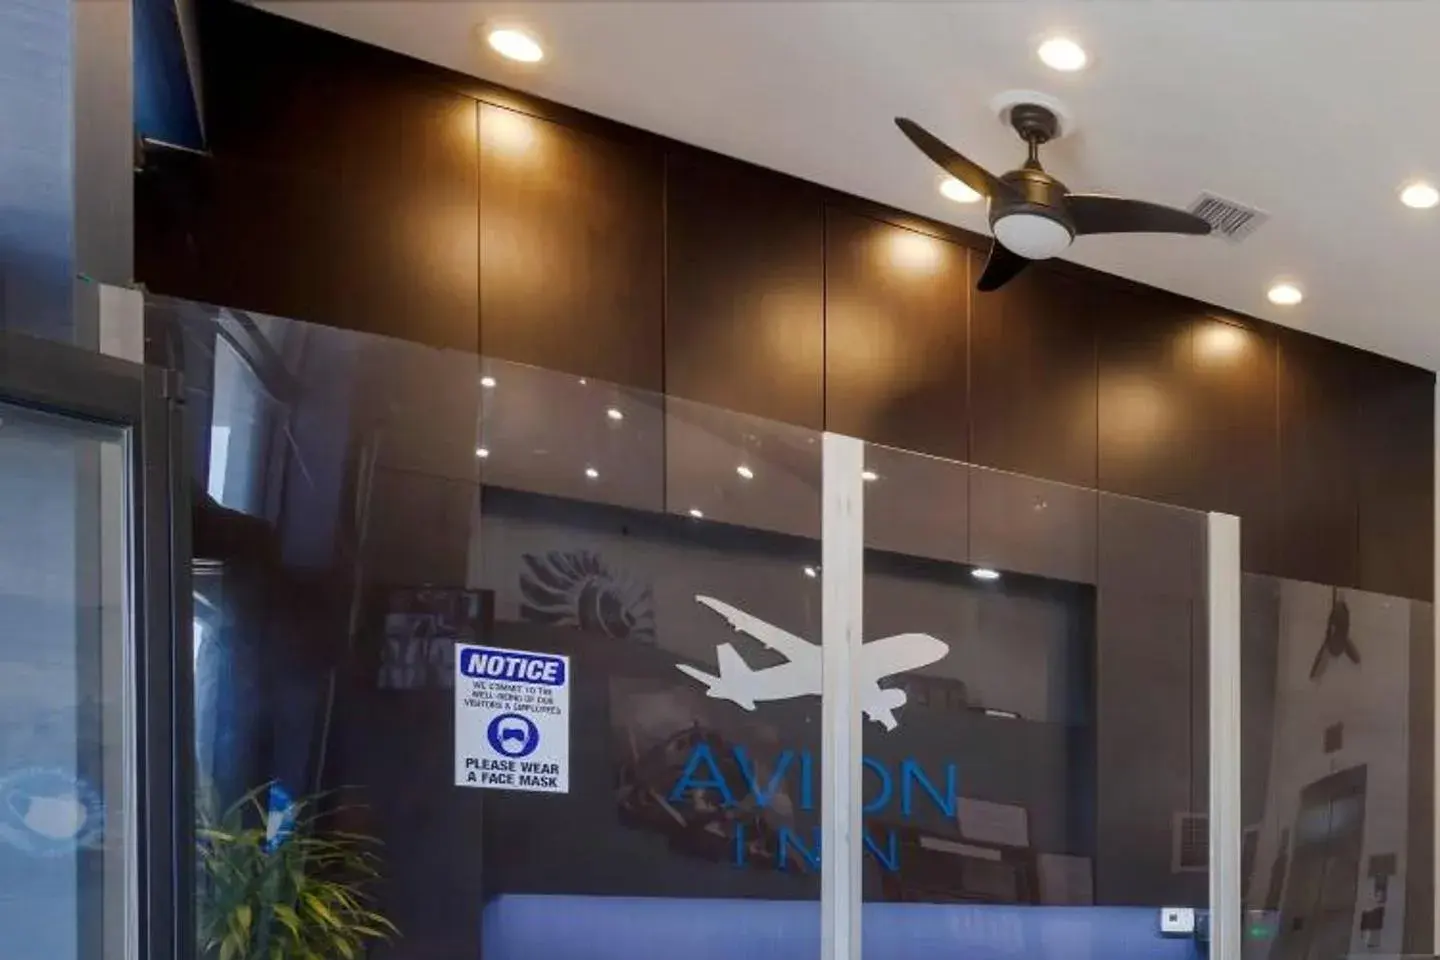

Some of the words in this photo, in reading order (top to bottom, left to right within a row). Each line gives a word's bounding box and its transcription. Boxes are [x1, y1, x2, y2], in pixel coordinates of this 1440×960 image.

[468, 653, 559, 682] NOTICE
[473, 681, 486, 690] WE
[525, 686, 536, 694] TO
[466, 757, 516, 772] PLEASE
[521, 761, 559, 775] WEAR
[467, 771, 477, 783] A
[481, 772, 515, 785] FACE
[520, 775, 558, 788] MASK
